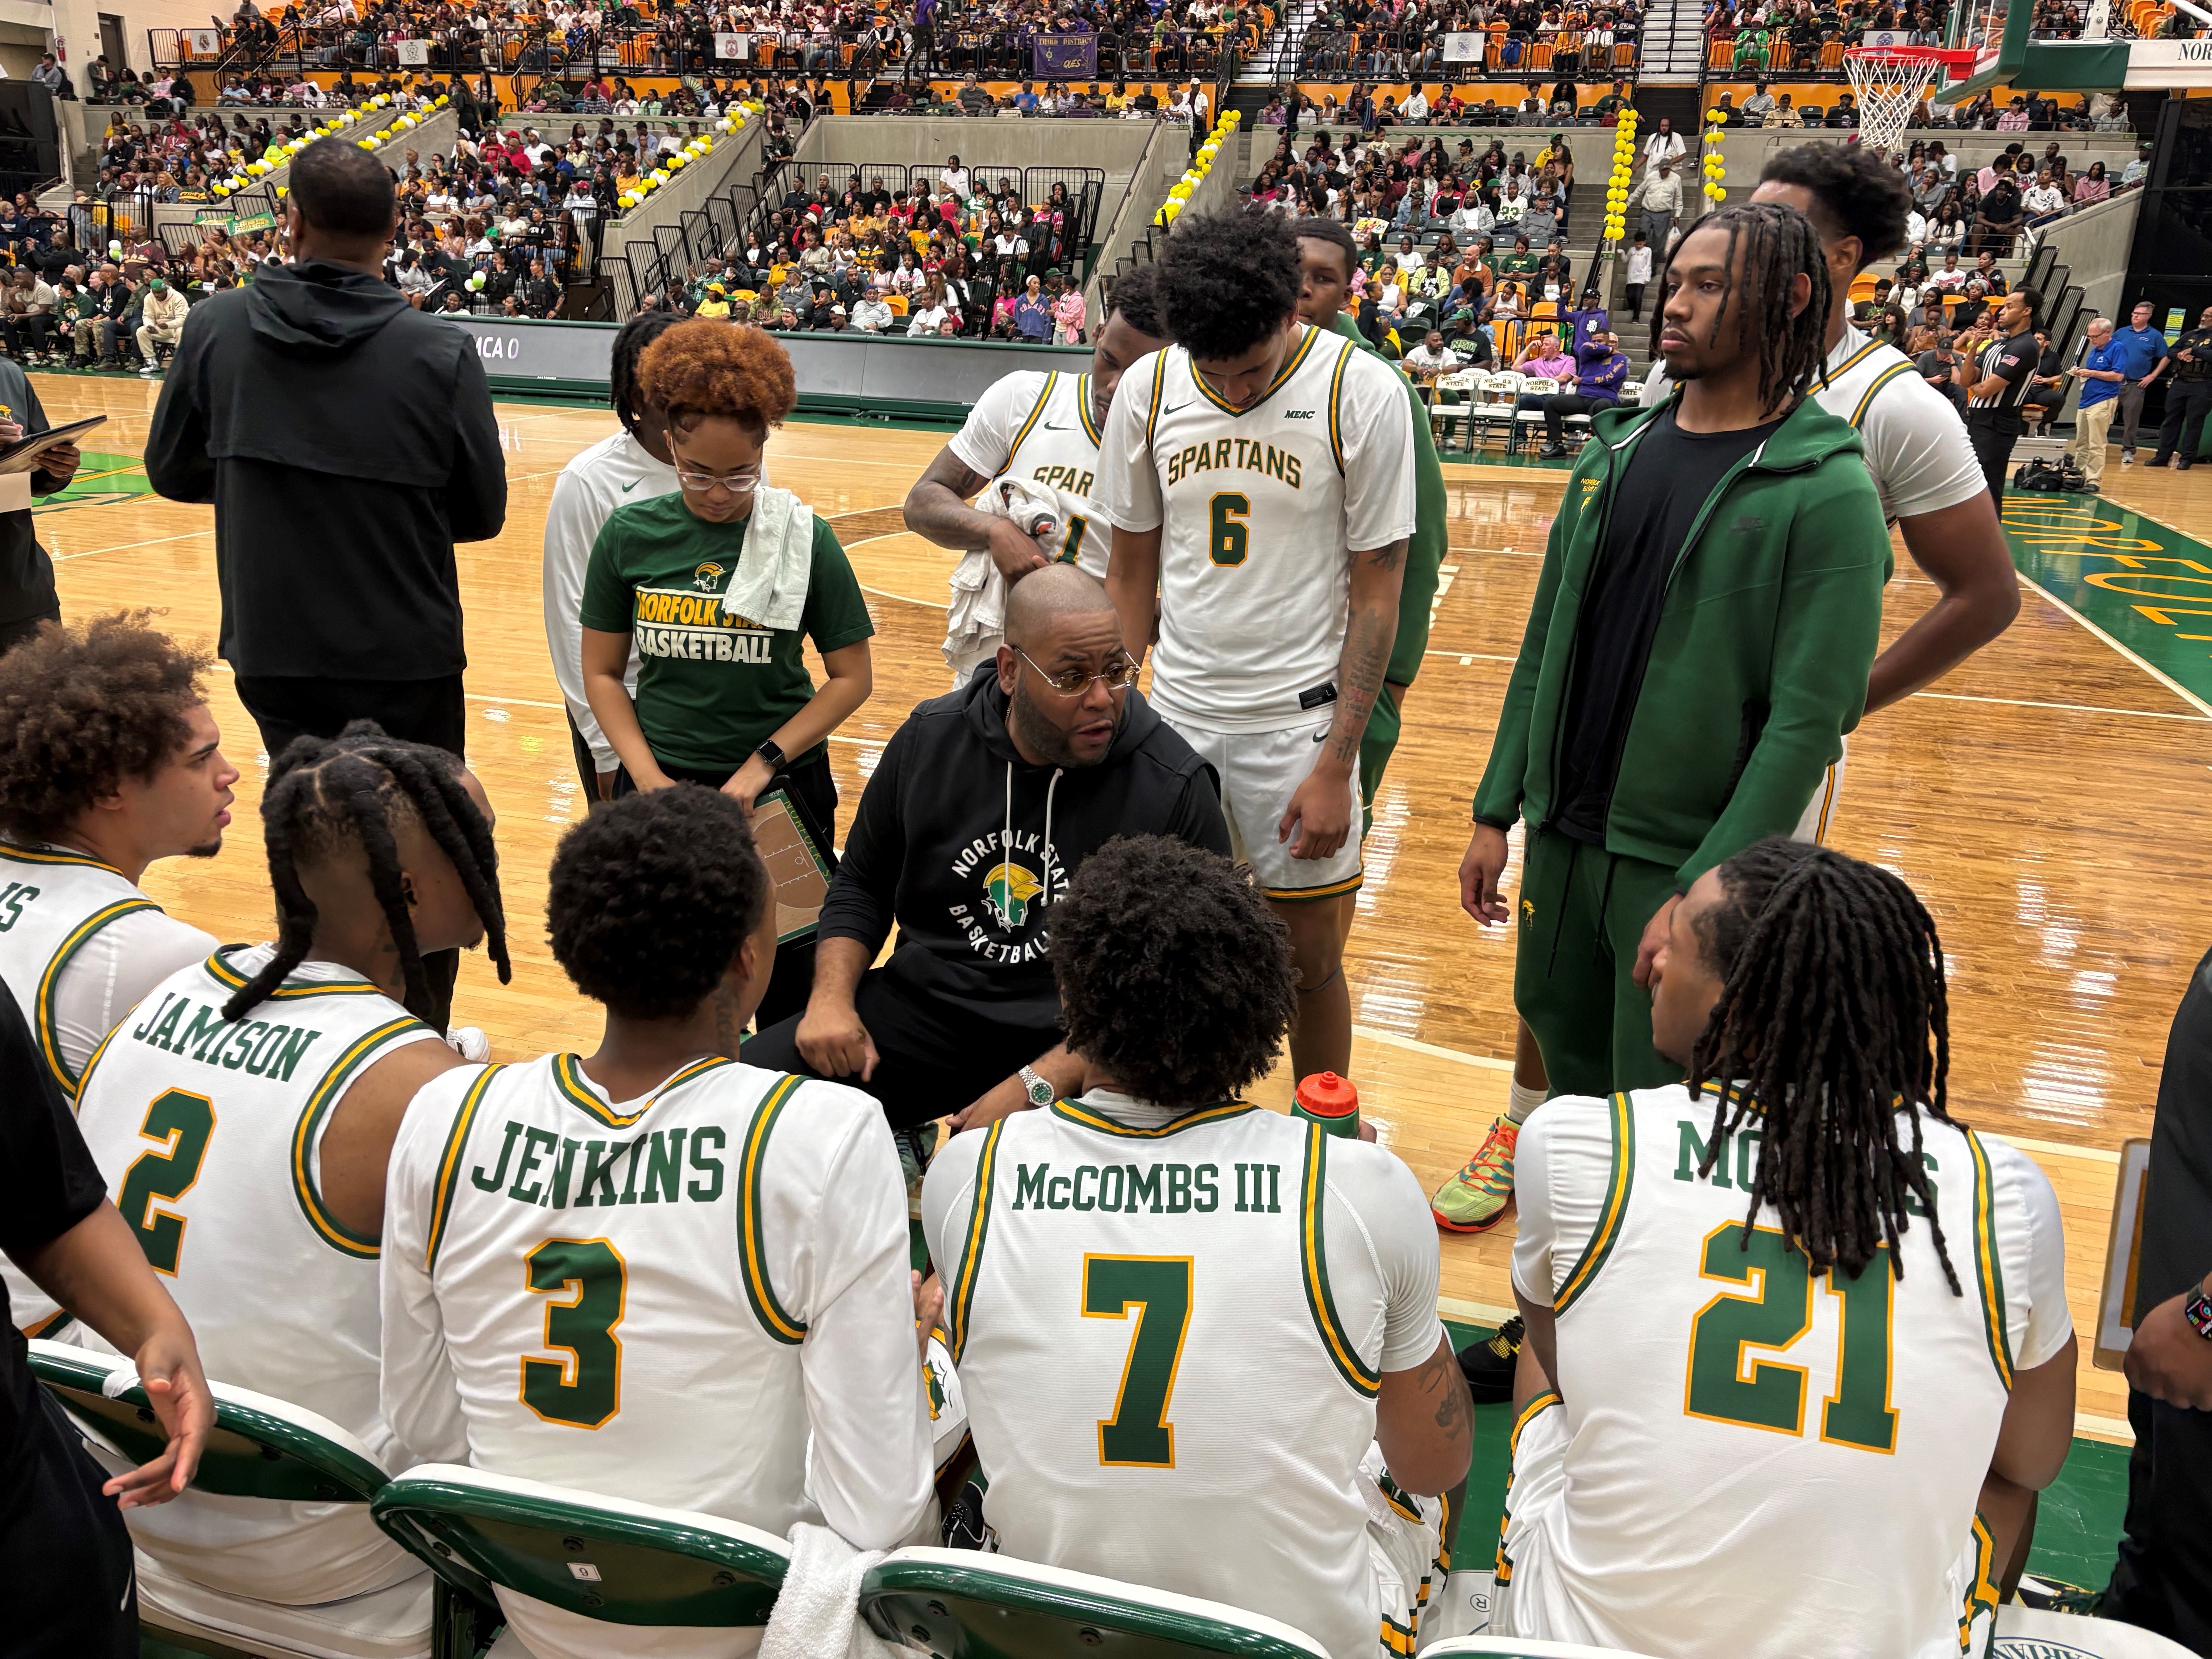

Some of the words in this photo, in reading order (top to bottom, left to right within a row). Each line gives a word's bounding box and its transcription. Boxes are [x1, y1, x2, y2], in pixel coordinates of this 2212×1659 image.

[1063, 36, 1092, 45] DISTRICT
[1063, 59, 1082, 69] QUES
[1285, 410, 1315, 419] MEAC
[1168, 438, 1302, 490] SPARTANS
[1054, 514, 1089, 565] 1
[1209, 491, 1250, 567] 6
[636, 591, 719, 626] NORFOLK
[636, 626, 772, 664] BASKETBALL
[784, 801, 821, 860] NORFOLK
[952, 830, 1040, 878] NORFOLK
[133, 992, 322, 1082] JAMISON
[117, 1087, 217, 1278] 2
[471, 1120, 726, 1209] JENKINS
[1012, 1163, 1219, 1213] McCOMBS
[1235, 1163, 1281, 1213] III
[519, 1237, 627, 1430] 3
[1684, 1219, 1900, 1455] 21
[1081, 1253, 1194, 1468] 7
[579, 1567, 589, 1577] 9
